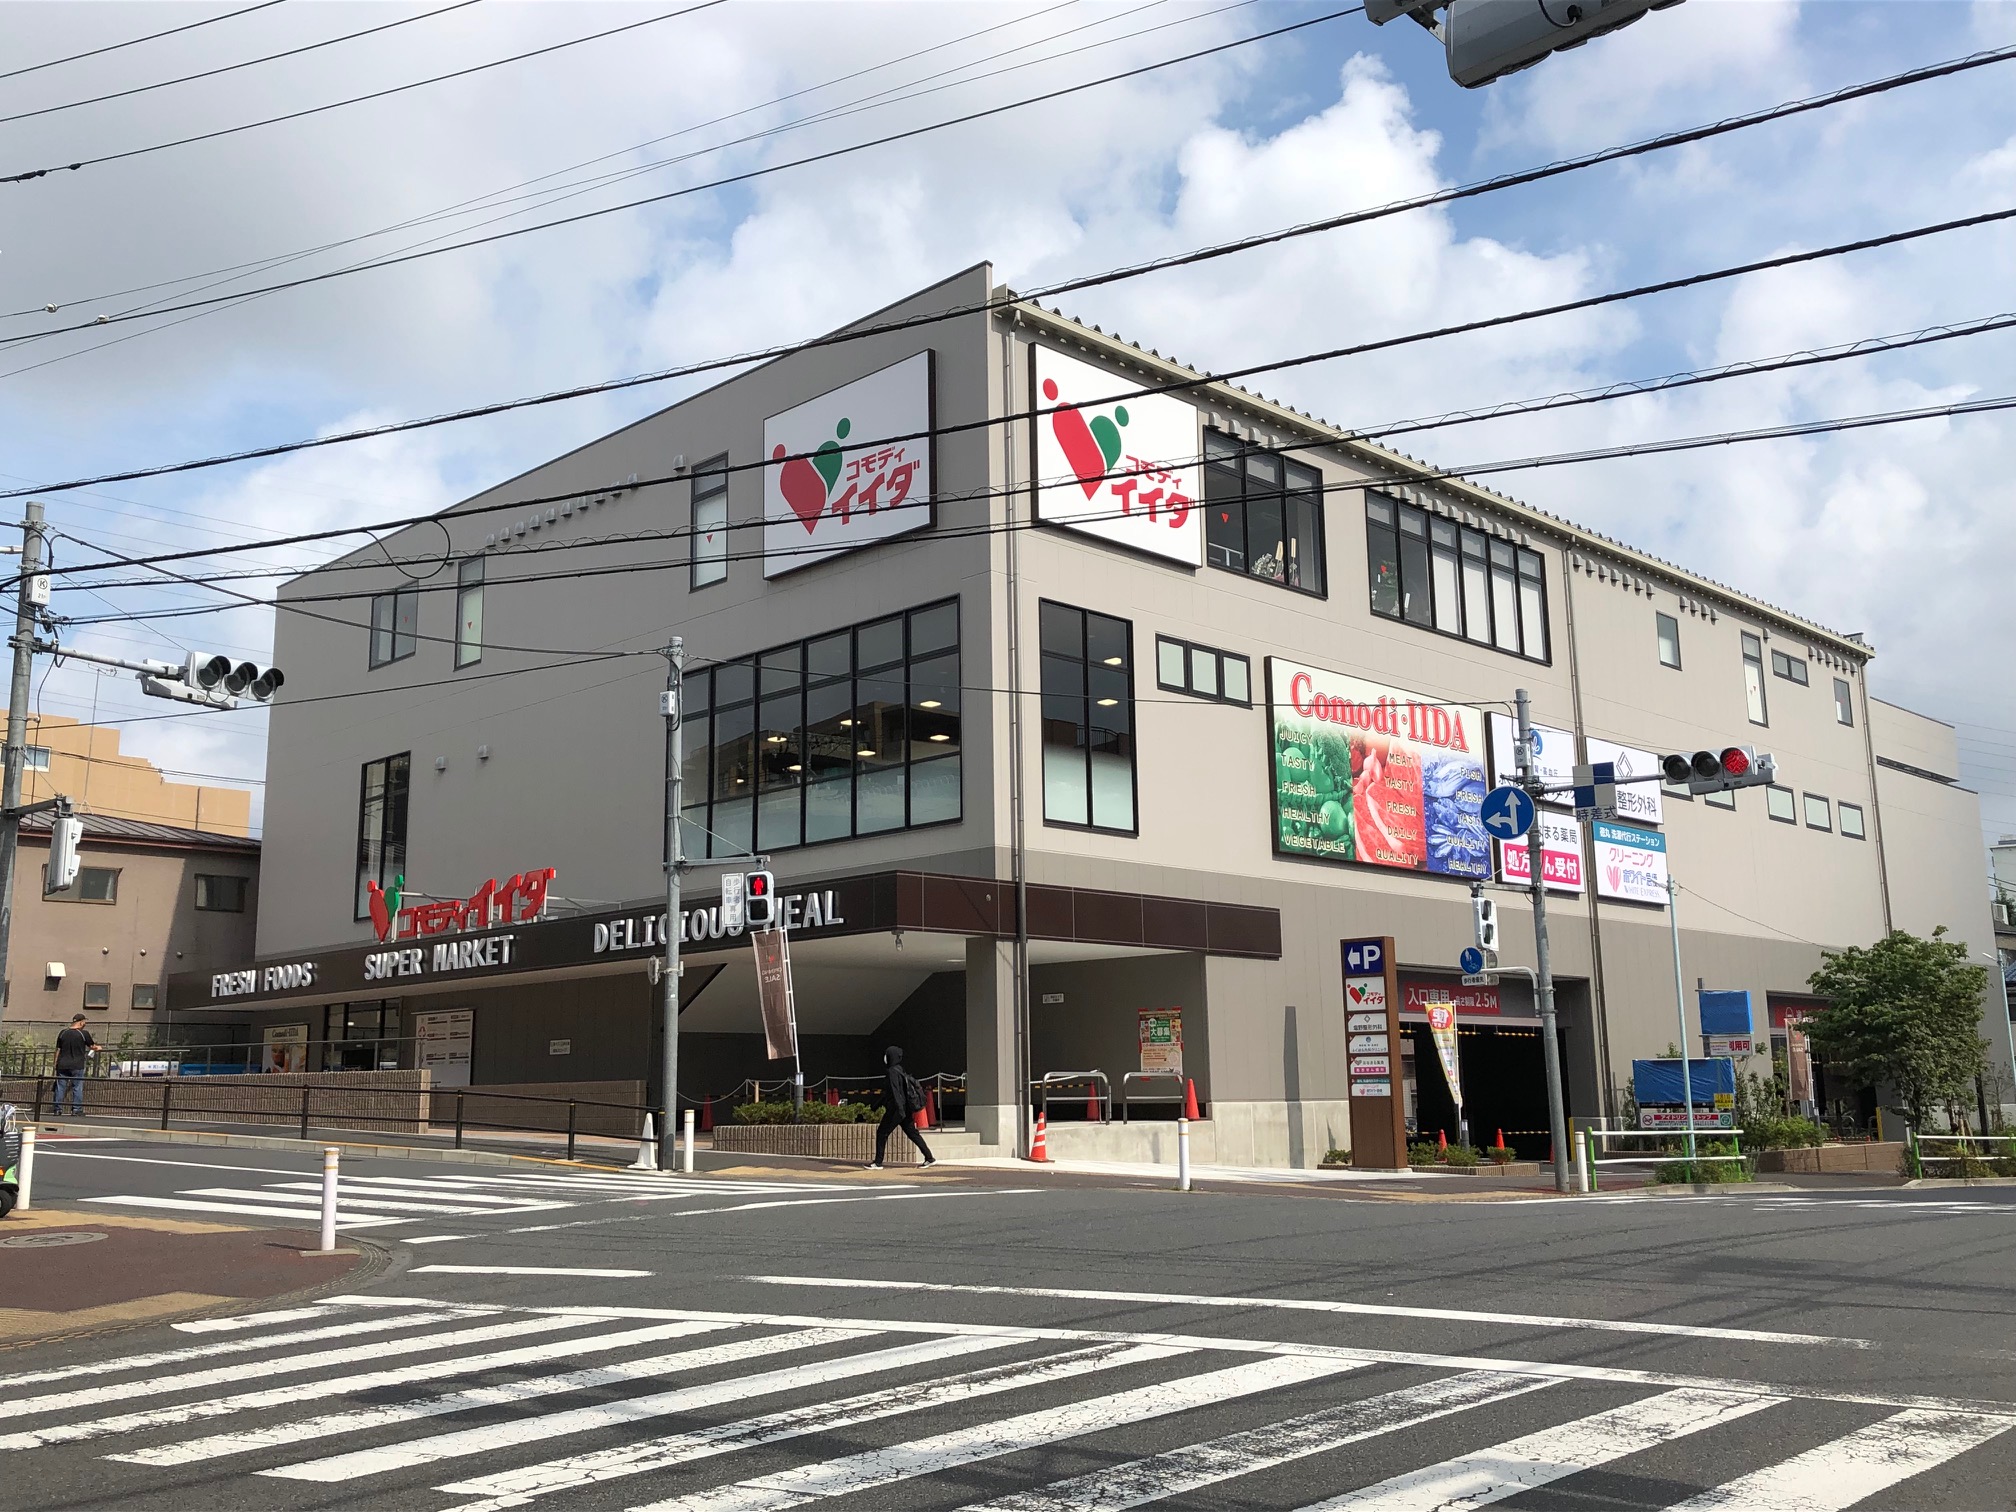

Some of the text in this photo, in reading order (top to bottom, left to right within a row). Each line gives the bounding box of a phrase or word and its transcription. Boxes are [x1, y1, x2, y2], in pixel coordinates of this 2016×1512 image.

[846, 445, 907, 482] コモディ
[1125, 455, 1182, 489] コモディ
[831, 461, 921, 526] イイダ
[1110, 478, 1196, 529] イイダ
[1279, 729, 1313, 746] JUICY
[1280, 754, 1315, 771] TASTY
[1389, 753, 1413, 769] MEAT
[1282, 781, 1316, 798] FRESH
[1384, 776, 1414, 792] TASTY
[1455, 791, 1483, 805] FRESH
[1616, 790, 1657, 817] 整形外科
[1282, 808, 1330, 825] HEALTHY
[1386, 801, 1417, 817] FRESH
[1576, 806, 1618, 822] 時差式
[1387, 825, 1417, 841] DAILY
[1284, 835, 1345, 853] VEGETABLE
[1447, 835, 1486, 852] QUALITY
[1375, 849, 1419, 866] QUALITY
[1507, 849, 1578, 880] 処方ん受付
[1609, 847, 1653, 868] クリーニング
[1448, 859, 1487, 875] HEALTHY
[398, 867, 557, 938] コモディ イイダ
[364, 934, 515, 981] SUPER MARKET
[1363, 945, 1381, 970] P
[211, 961, 314, 997] FRESH FOODS
[1363, 996, 1385, 1006] イイダ
[1408, 987, 1450, 1005] 入口専用
[1475, 992, 1498, 1009] 2.5M
